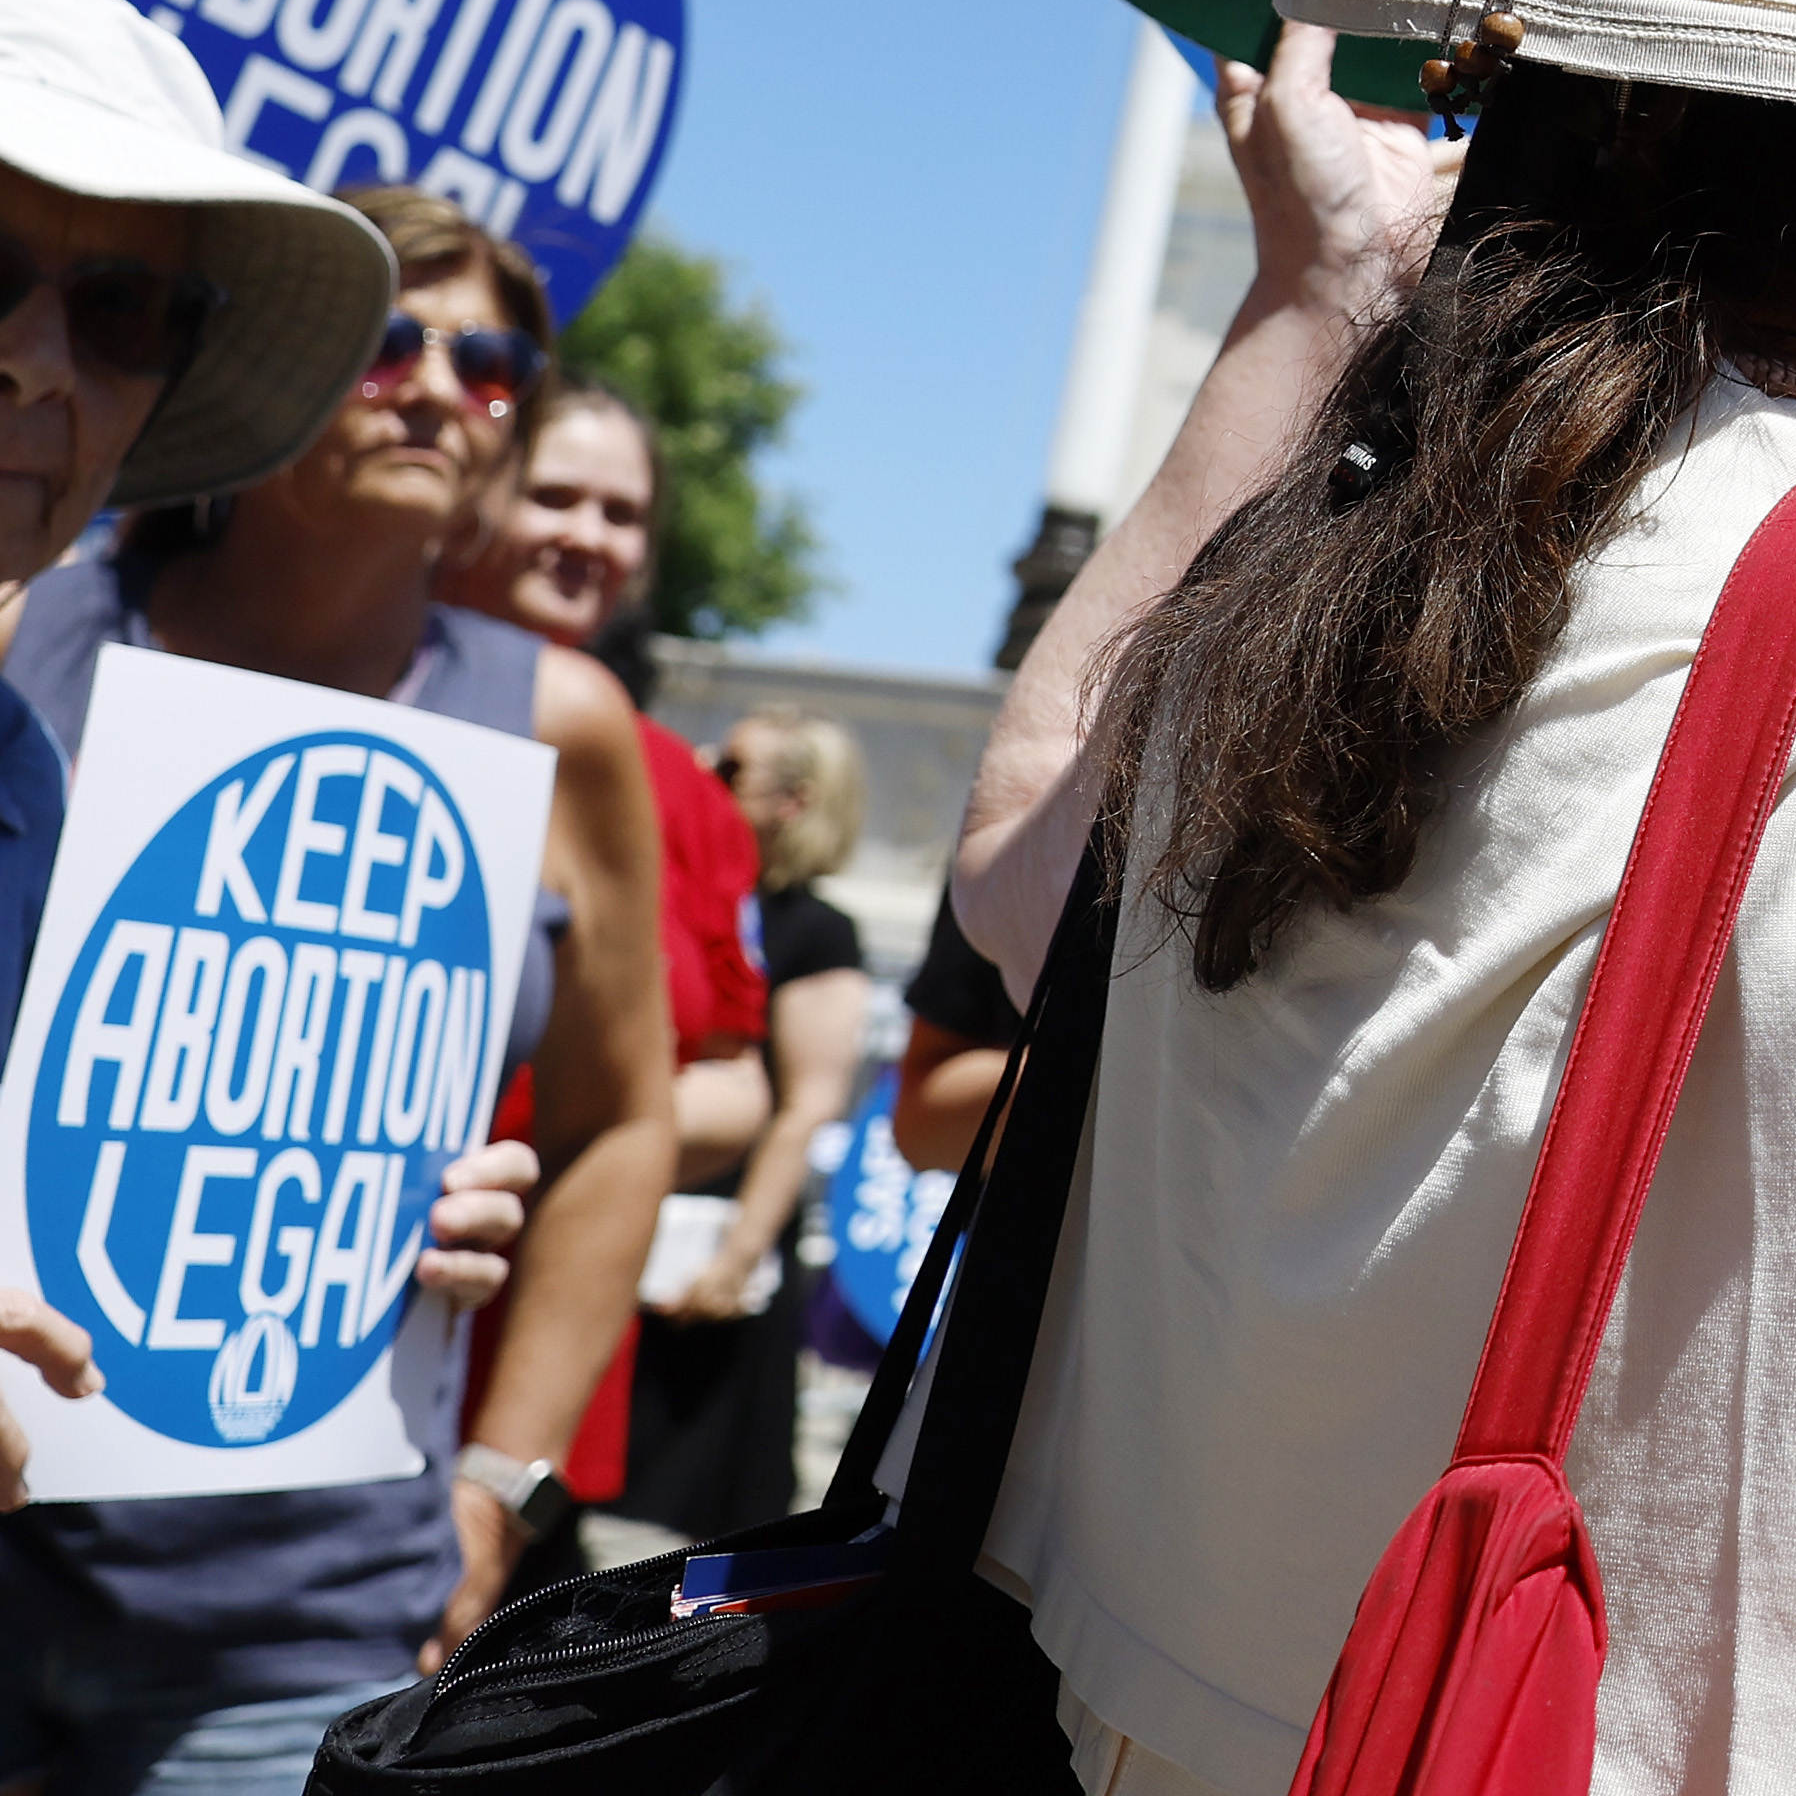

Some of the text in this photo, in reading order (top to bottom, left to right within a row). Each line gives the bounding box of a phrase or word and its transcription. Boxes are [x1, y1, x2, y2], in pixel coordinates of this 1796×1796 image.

[194, 744, 466, 948] KEEP
[57, 919, 489, 1153] ABORTION
[75, 1139, 425, 1350] LEGAL
